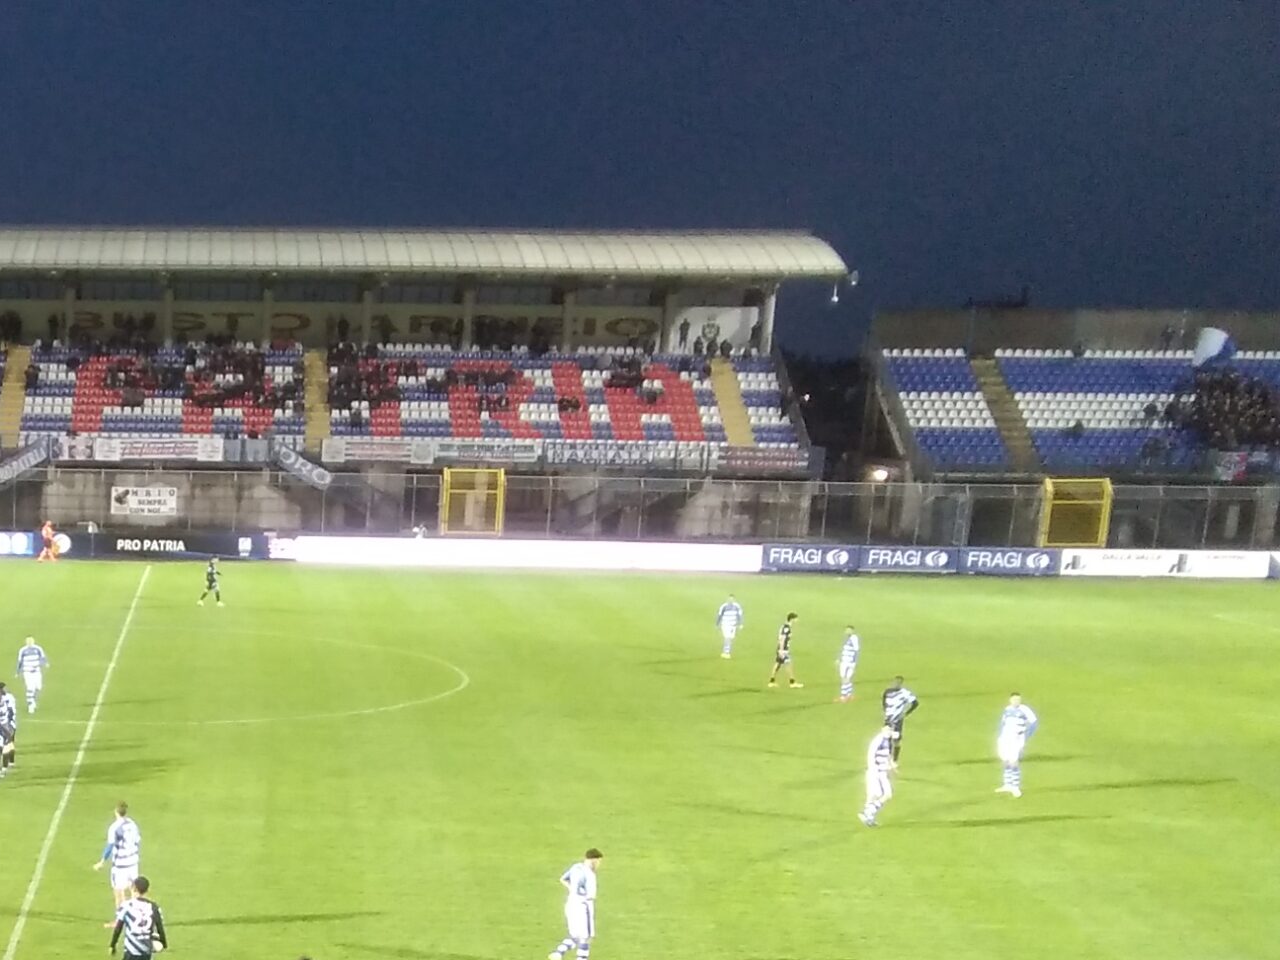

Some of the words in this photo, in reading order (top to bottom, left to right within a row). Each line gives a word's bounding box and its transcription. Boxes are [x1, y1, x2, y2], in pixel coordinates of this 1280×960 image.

[117, 539, 142, 551] PRO
[143, 539, 186, 552] PATRIA
[770, 548, 822, 565] FRAGI
[868, 549, 921, 566] FRAGI
[967, 551, 1022, 568] FRAGI
